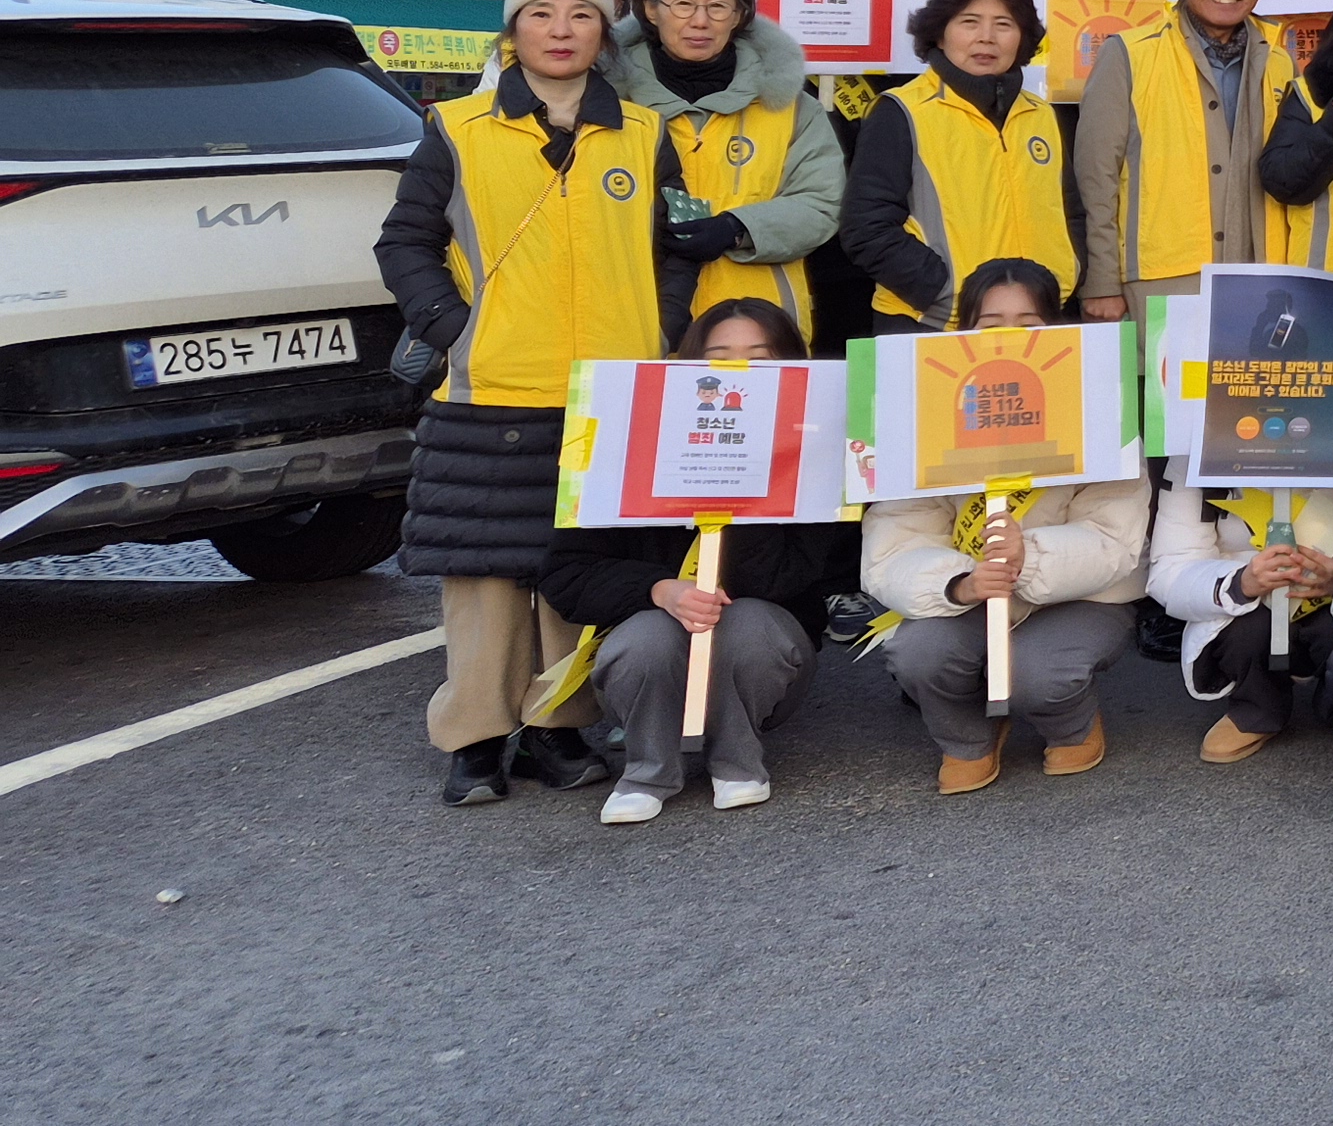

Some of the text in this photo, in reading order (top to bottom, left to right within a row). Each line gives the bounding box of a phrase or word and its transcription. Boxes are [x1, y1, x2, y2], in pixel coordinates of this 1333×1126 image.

[403, 34, 435, 55] 돈까스
[196, 200, 290, 229] KIA
[1263, 386, 1275, 397] 수
[996, 398, 1025, 412] 112
[696, 417, 736, 430] 청소년
[718, 432, 746, 445] 예방
